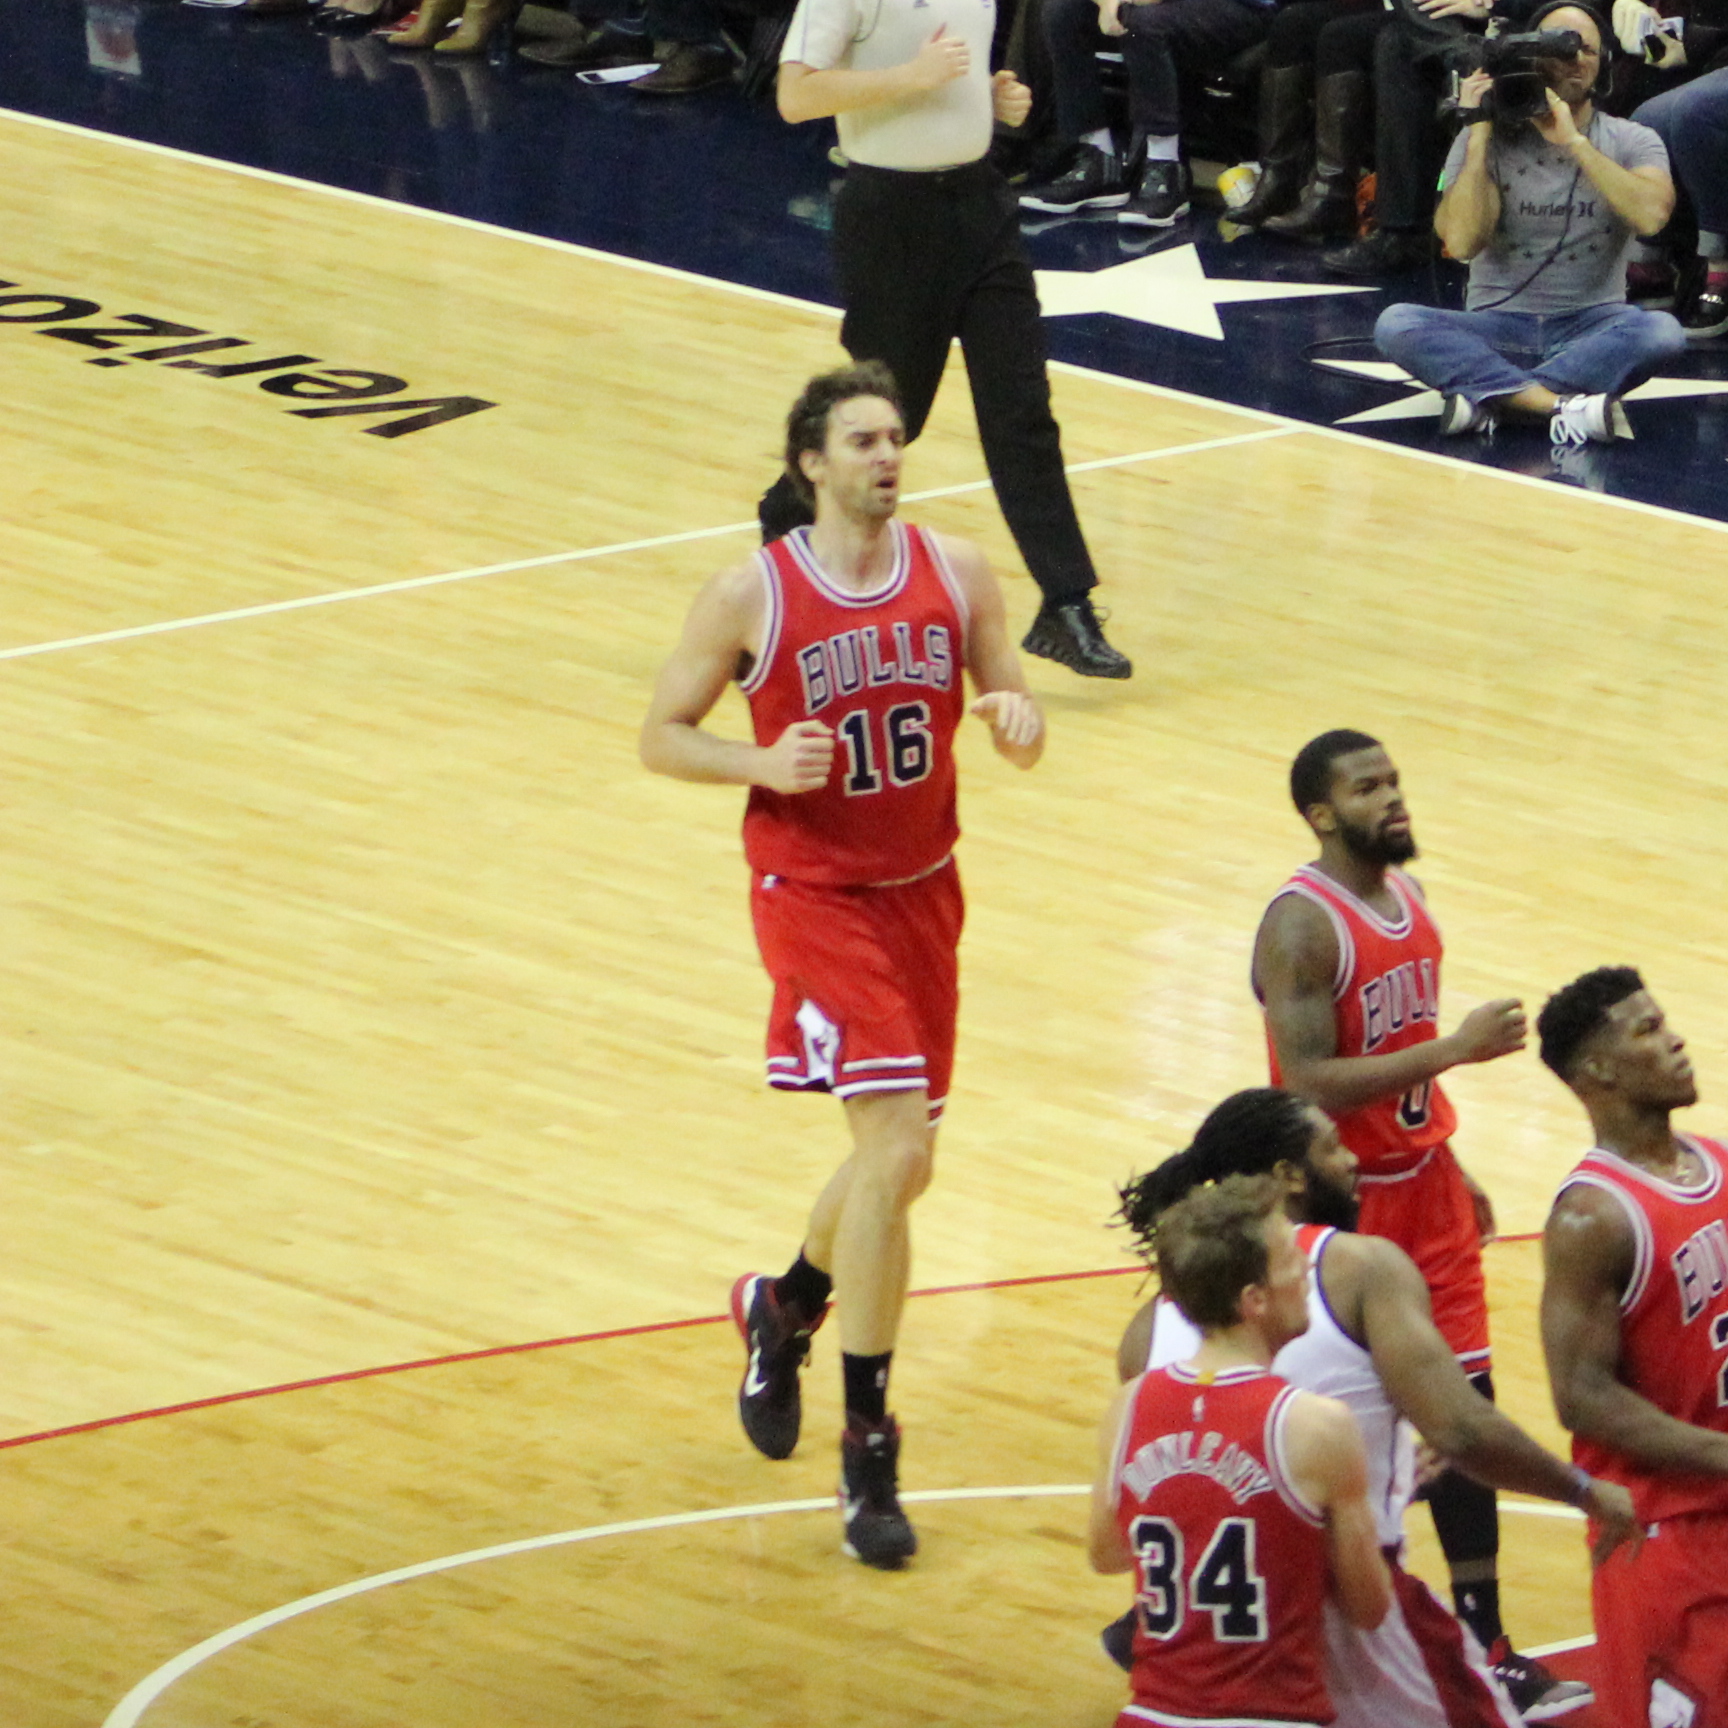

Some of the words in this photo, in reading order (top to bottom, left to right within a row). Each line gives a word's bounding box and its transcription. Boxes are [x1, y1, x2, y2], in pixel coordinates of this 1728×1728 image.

[1519, 201, 1575, 216] Hurley
[0, 280, 500, 439] verizo
[796, 620, 951, 716] BULLS
[837, 699, 935, 798] 16
[1358, 957, 1438, 1055] BULL
[1127, 1516, 1268, 1643] 34
